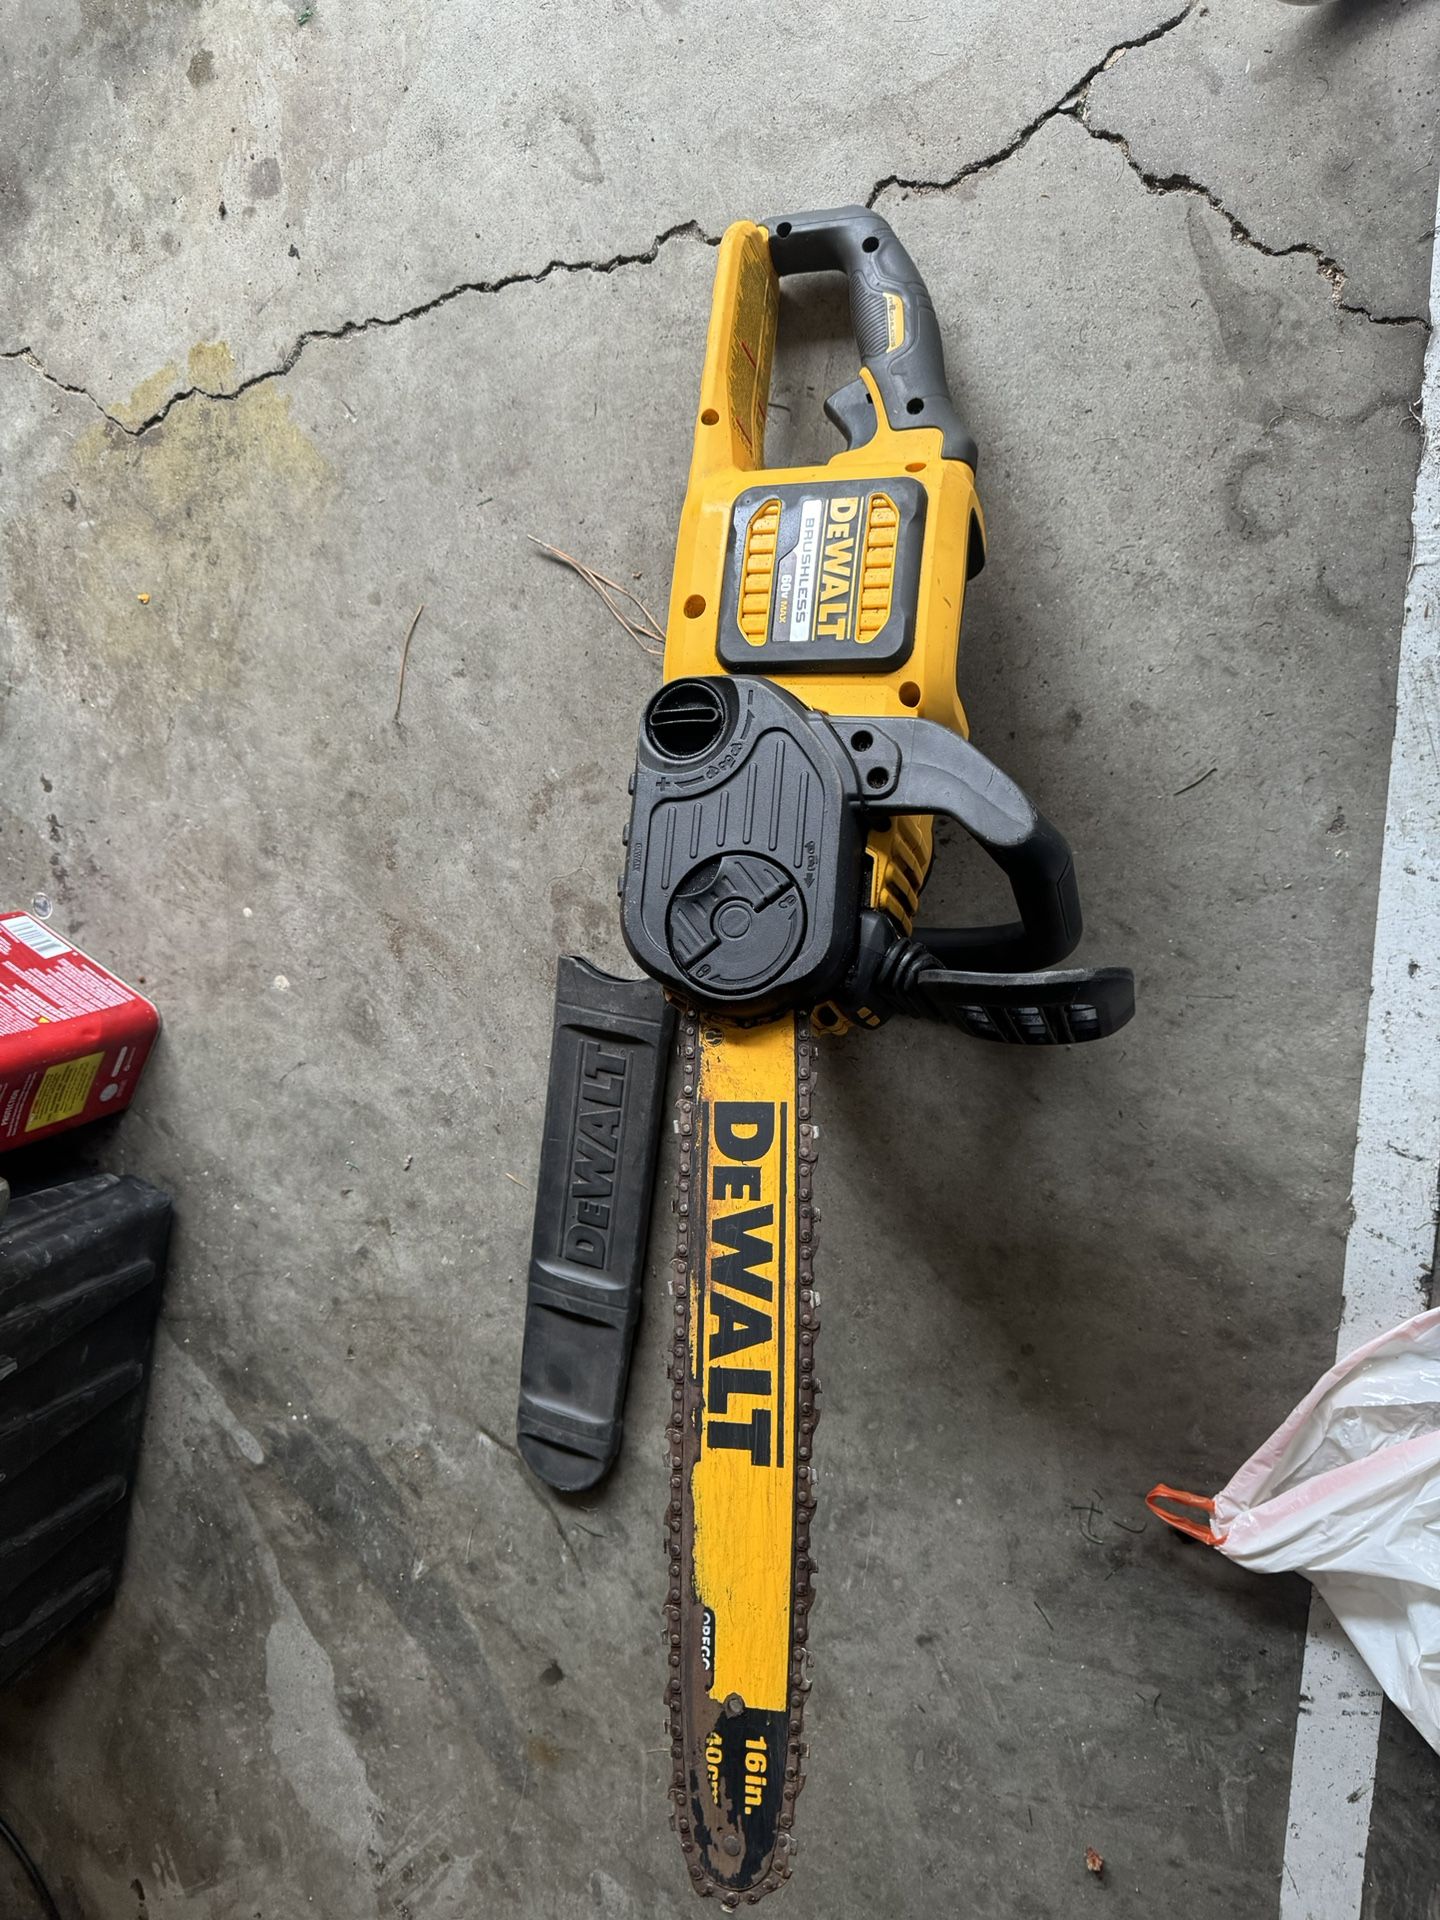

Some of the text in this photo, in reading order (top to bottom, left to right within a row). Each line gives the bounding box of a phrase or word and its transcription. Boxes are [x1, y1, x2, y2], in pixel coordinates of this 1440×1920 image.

[796, 517, 815, 624] BRUSHLESS
[817, 496, 859, 641] DEWALT
[565, 1041, 627, 1270] DEWALT
[706, 1101, 775, 1468] DEWALT
[744, 1735, 768, 1816] 16in.
